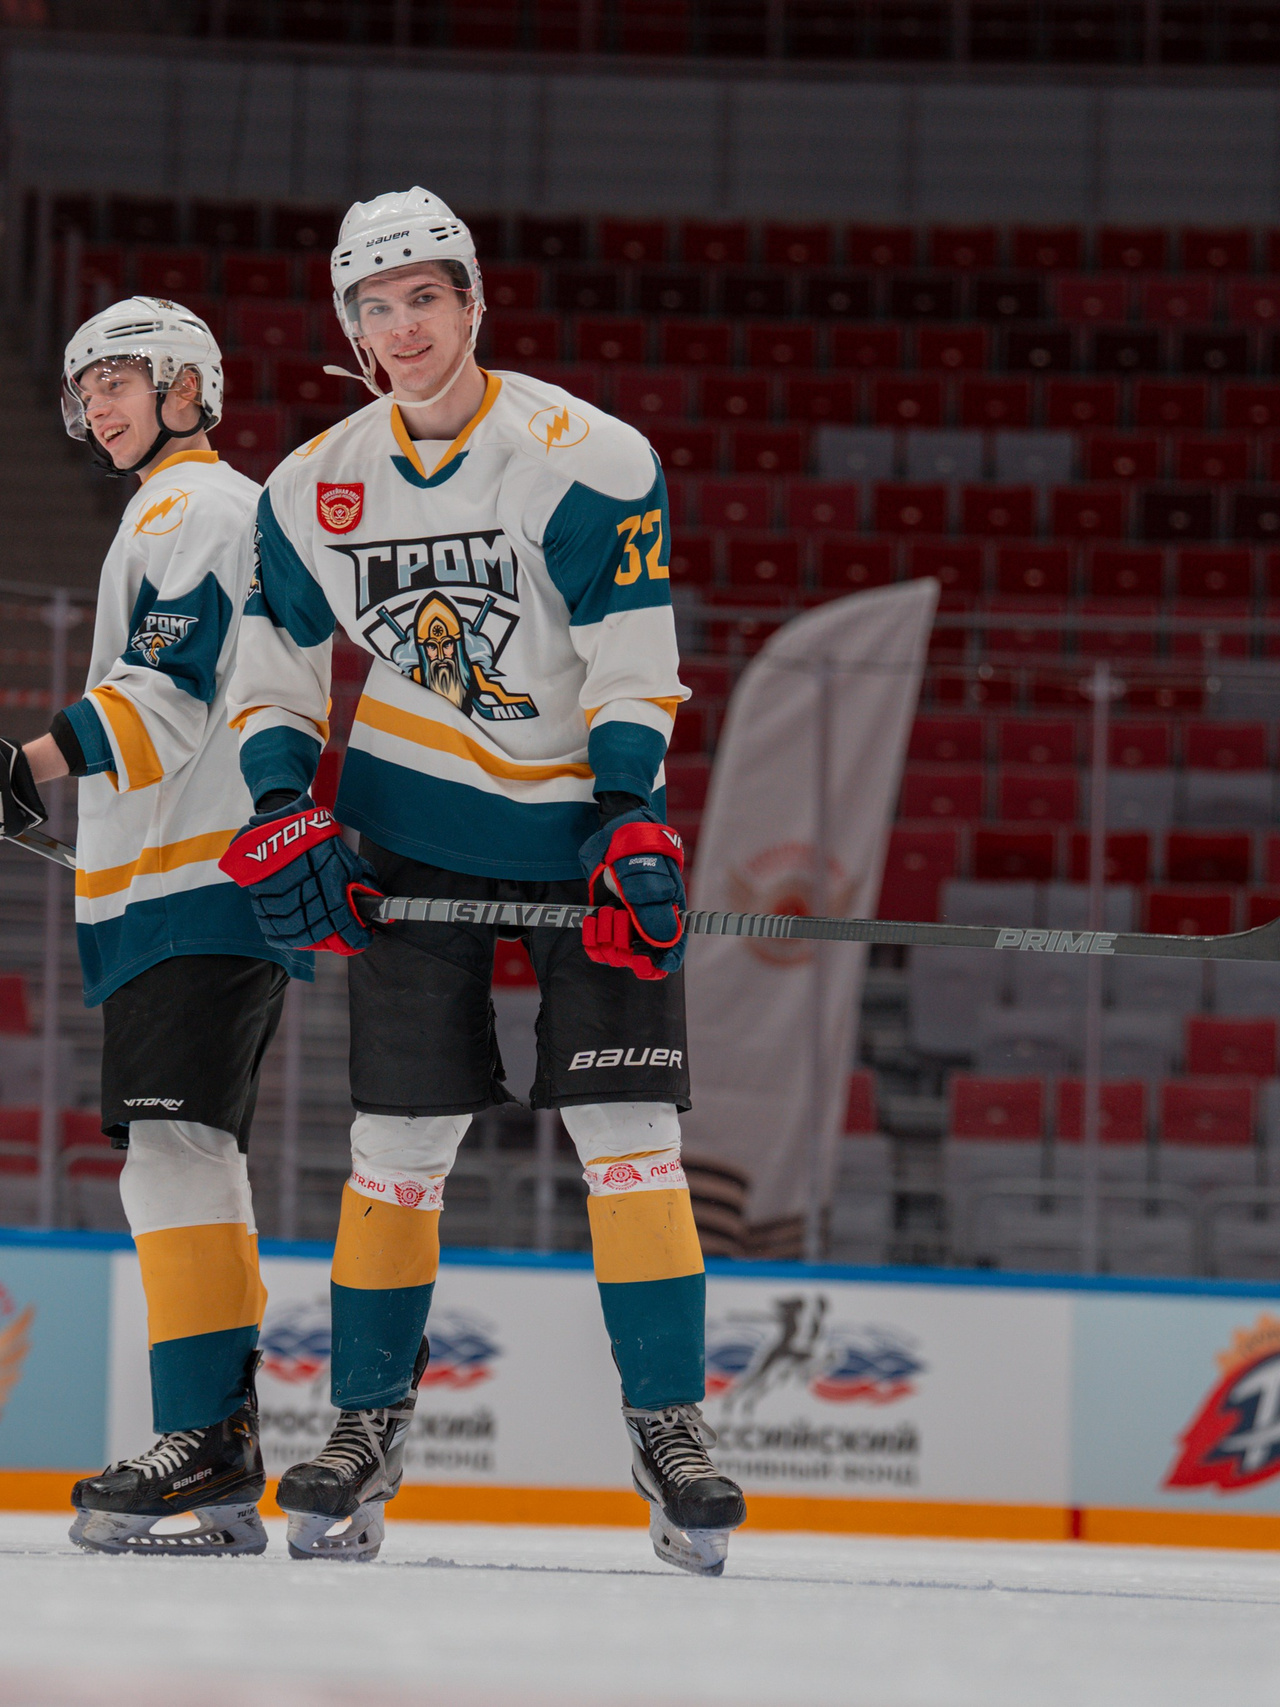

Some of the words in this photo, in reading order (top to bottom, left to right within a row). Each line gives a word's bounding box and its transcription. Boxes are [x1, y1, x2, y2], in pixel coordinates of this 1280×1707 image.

[366, 230, 410, 248] BAUER
[614, 509, 670, 586] 32
[359, 533, 514, 611] ГРОМ
[133, 615, 187, 640] РОМ
[661, 830, 684, 853] VI
[455, 903, 589, 929] SILVER
[995, 928, 1118, 955] PRIME
[568, 1047, 683, 1071] BAUER
[173, 1468, 212, 1490] BAUER
